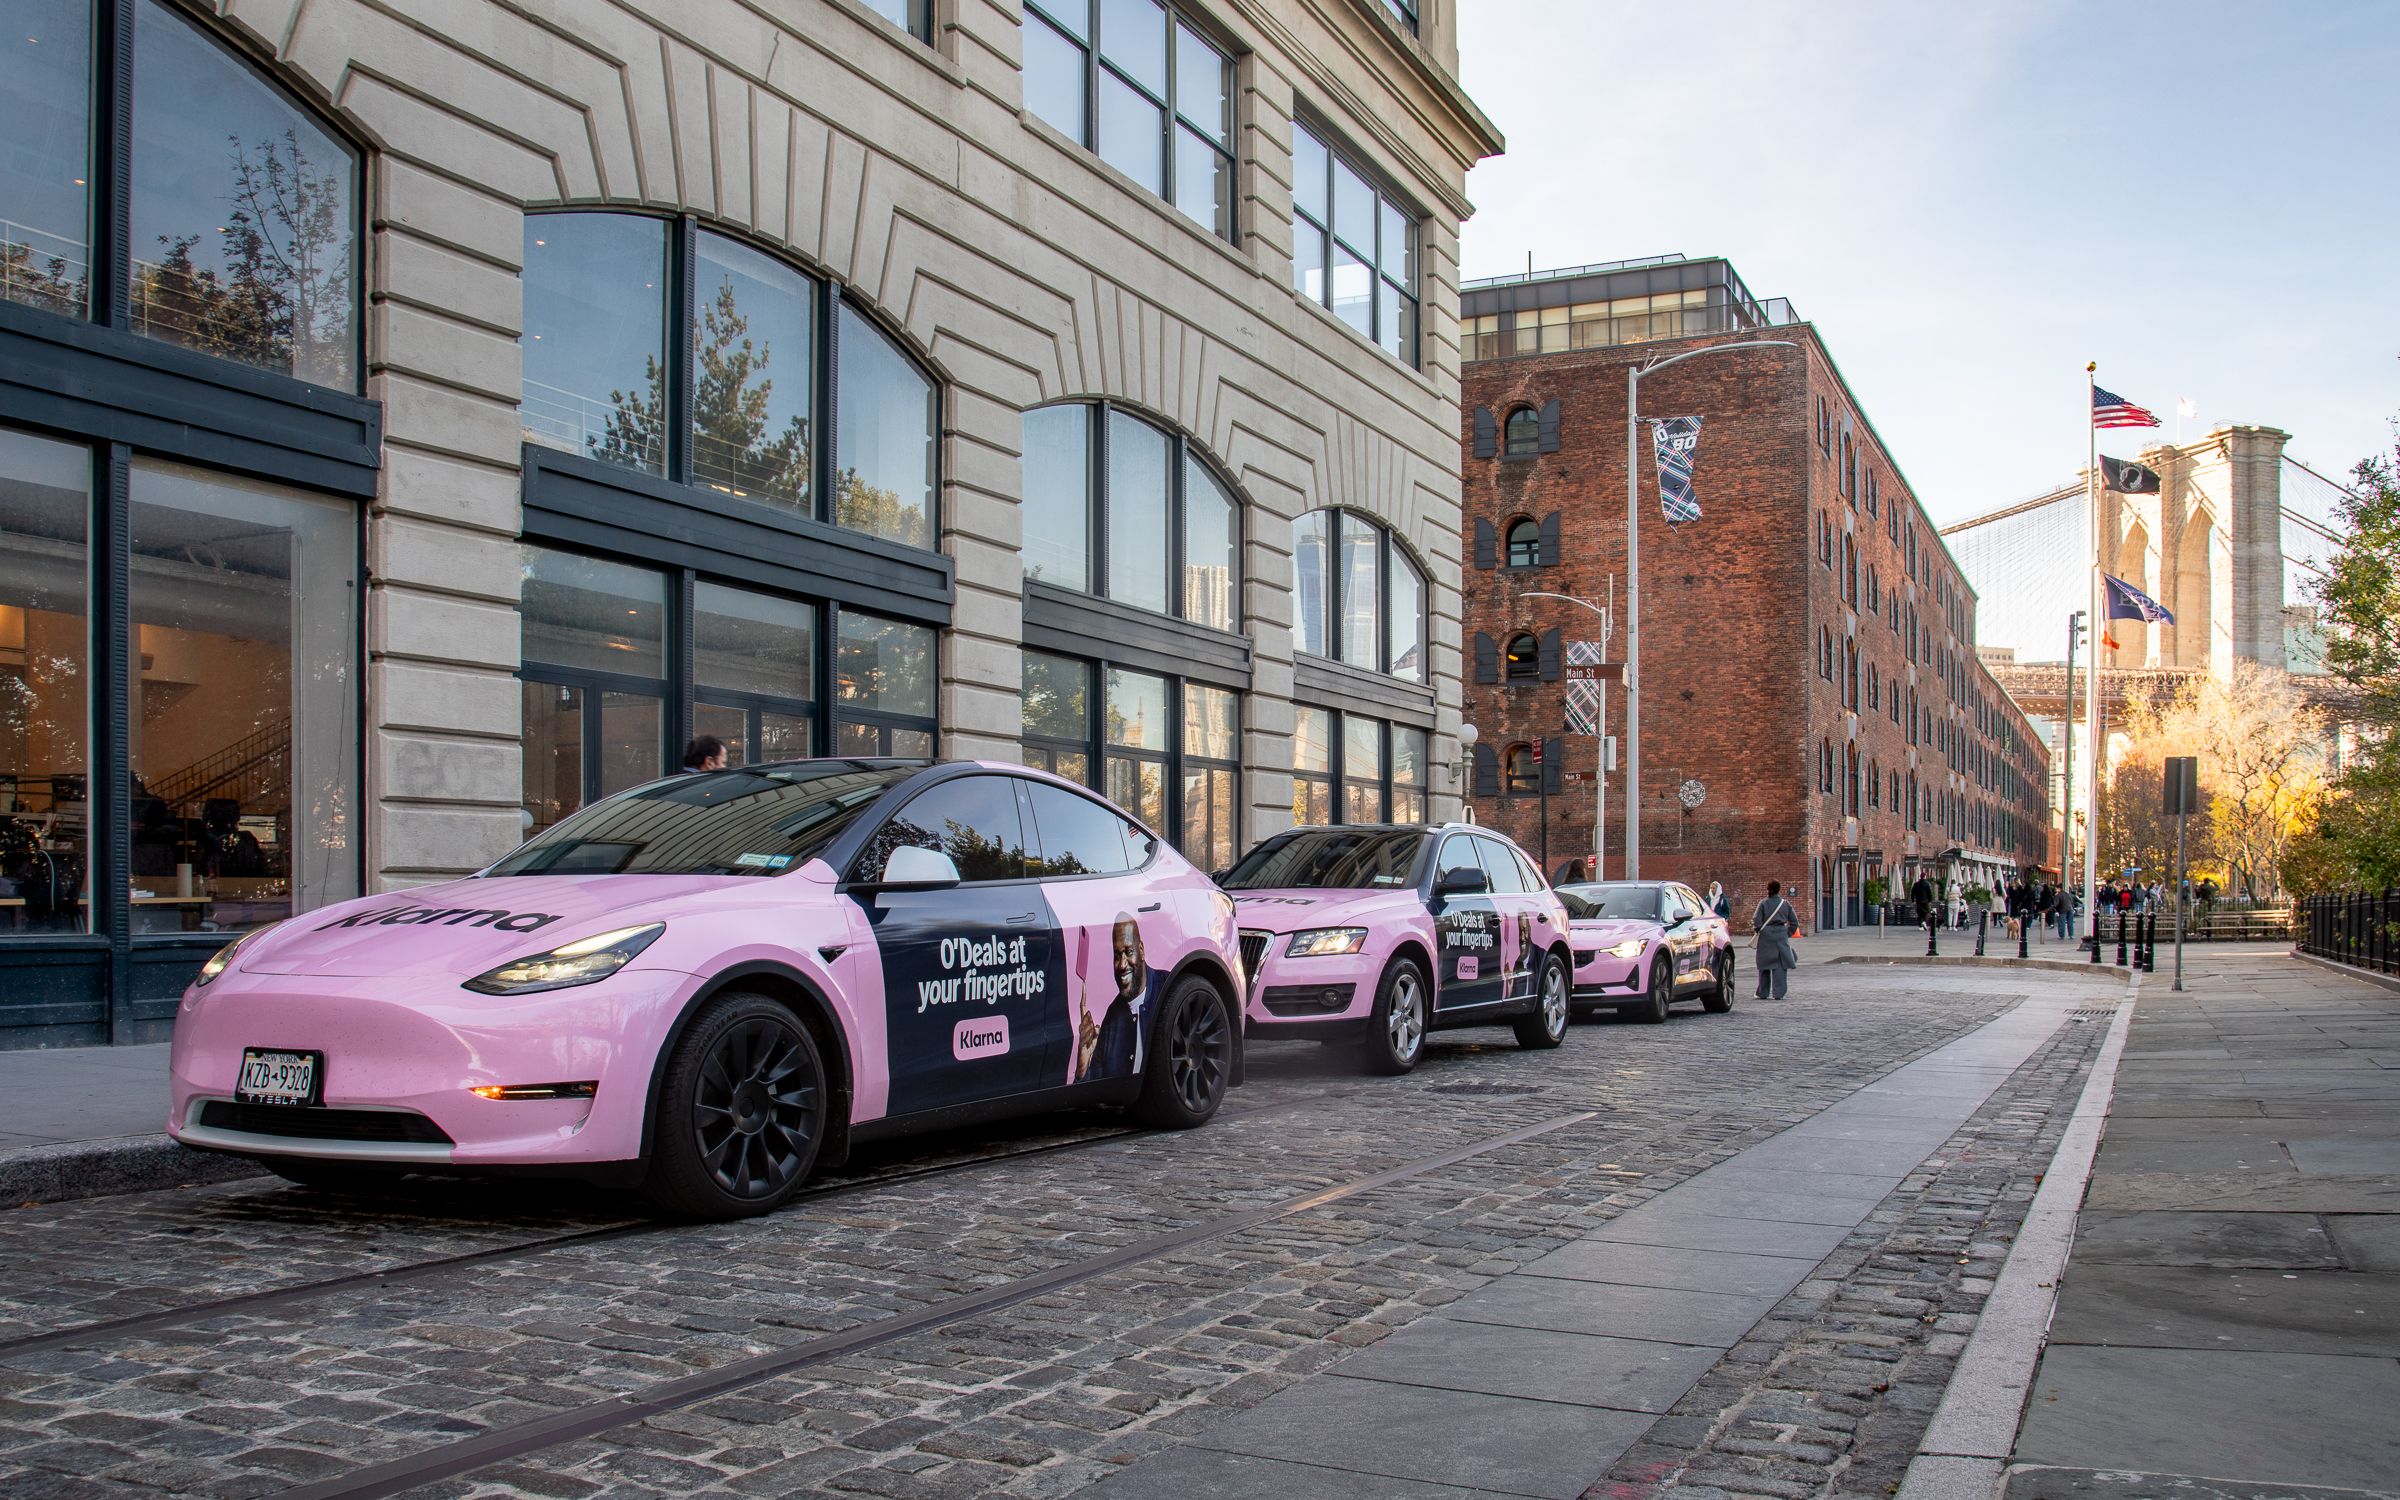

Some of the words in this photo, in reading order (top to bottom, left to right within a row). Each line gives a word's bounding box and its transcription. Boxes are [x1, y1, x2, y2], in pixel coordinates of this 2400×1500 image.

[1566, 668, 1583, 678] Main
[1586, 668, 1595, 678] St
[312, 905, 565, 933] Klarna
[1451, 910, 1477, 928] O'Deals
[1477, 913, 1486, 928] at
[1445, 931, 1461, 949] your
[1462, 927, 1493, 950] fingertips
[940, 934, 1007, 969] O'Deals
[1009, 935, 1026, 964] at
[1460, 963, 1476, 973] Klarna
[917, 978, 961, 1013] your
[964, 963, 1045, 1005] fingertips
[960, 1030, 1003, 1049] Klarna
[261, 1053, 277, 1062] NEW
[279, 1054, 299, 1064] YORK
[258, 1095, 298, 1105] TESLA
